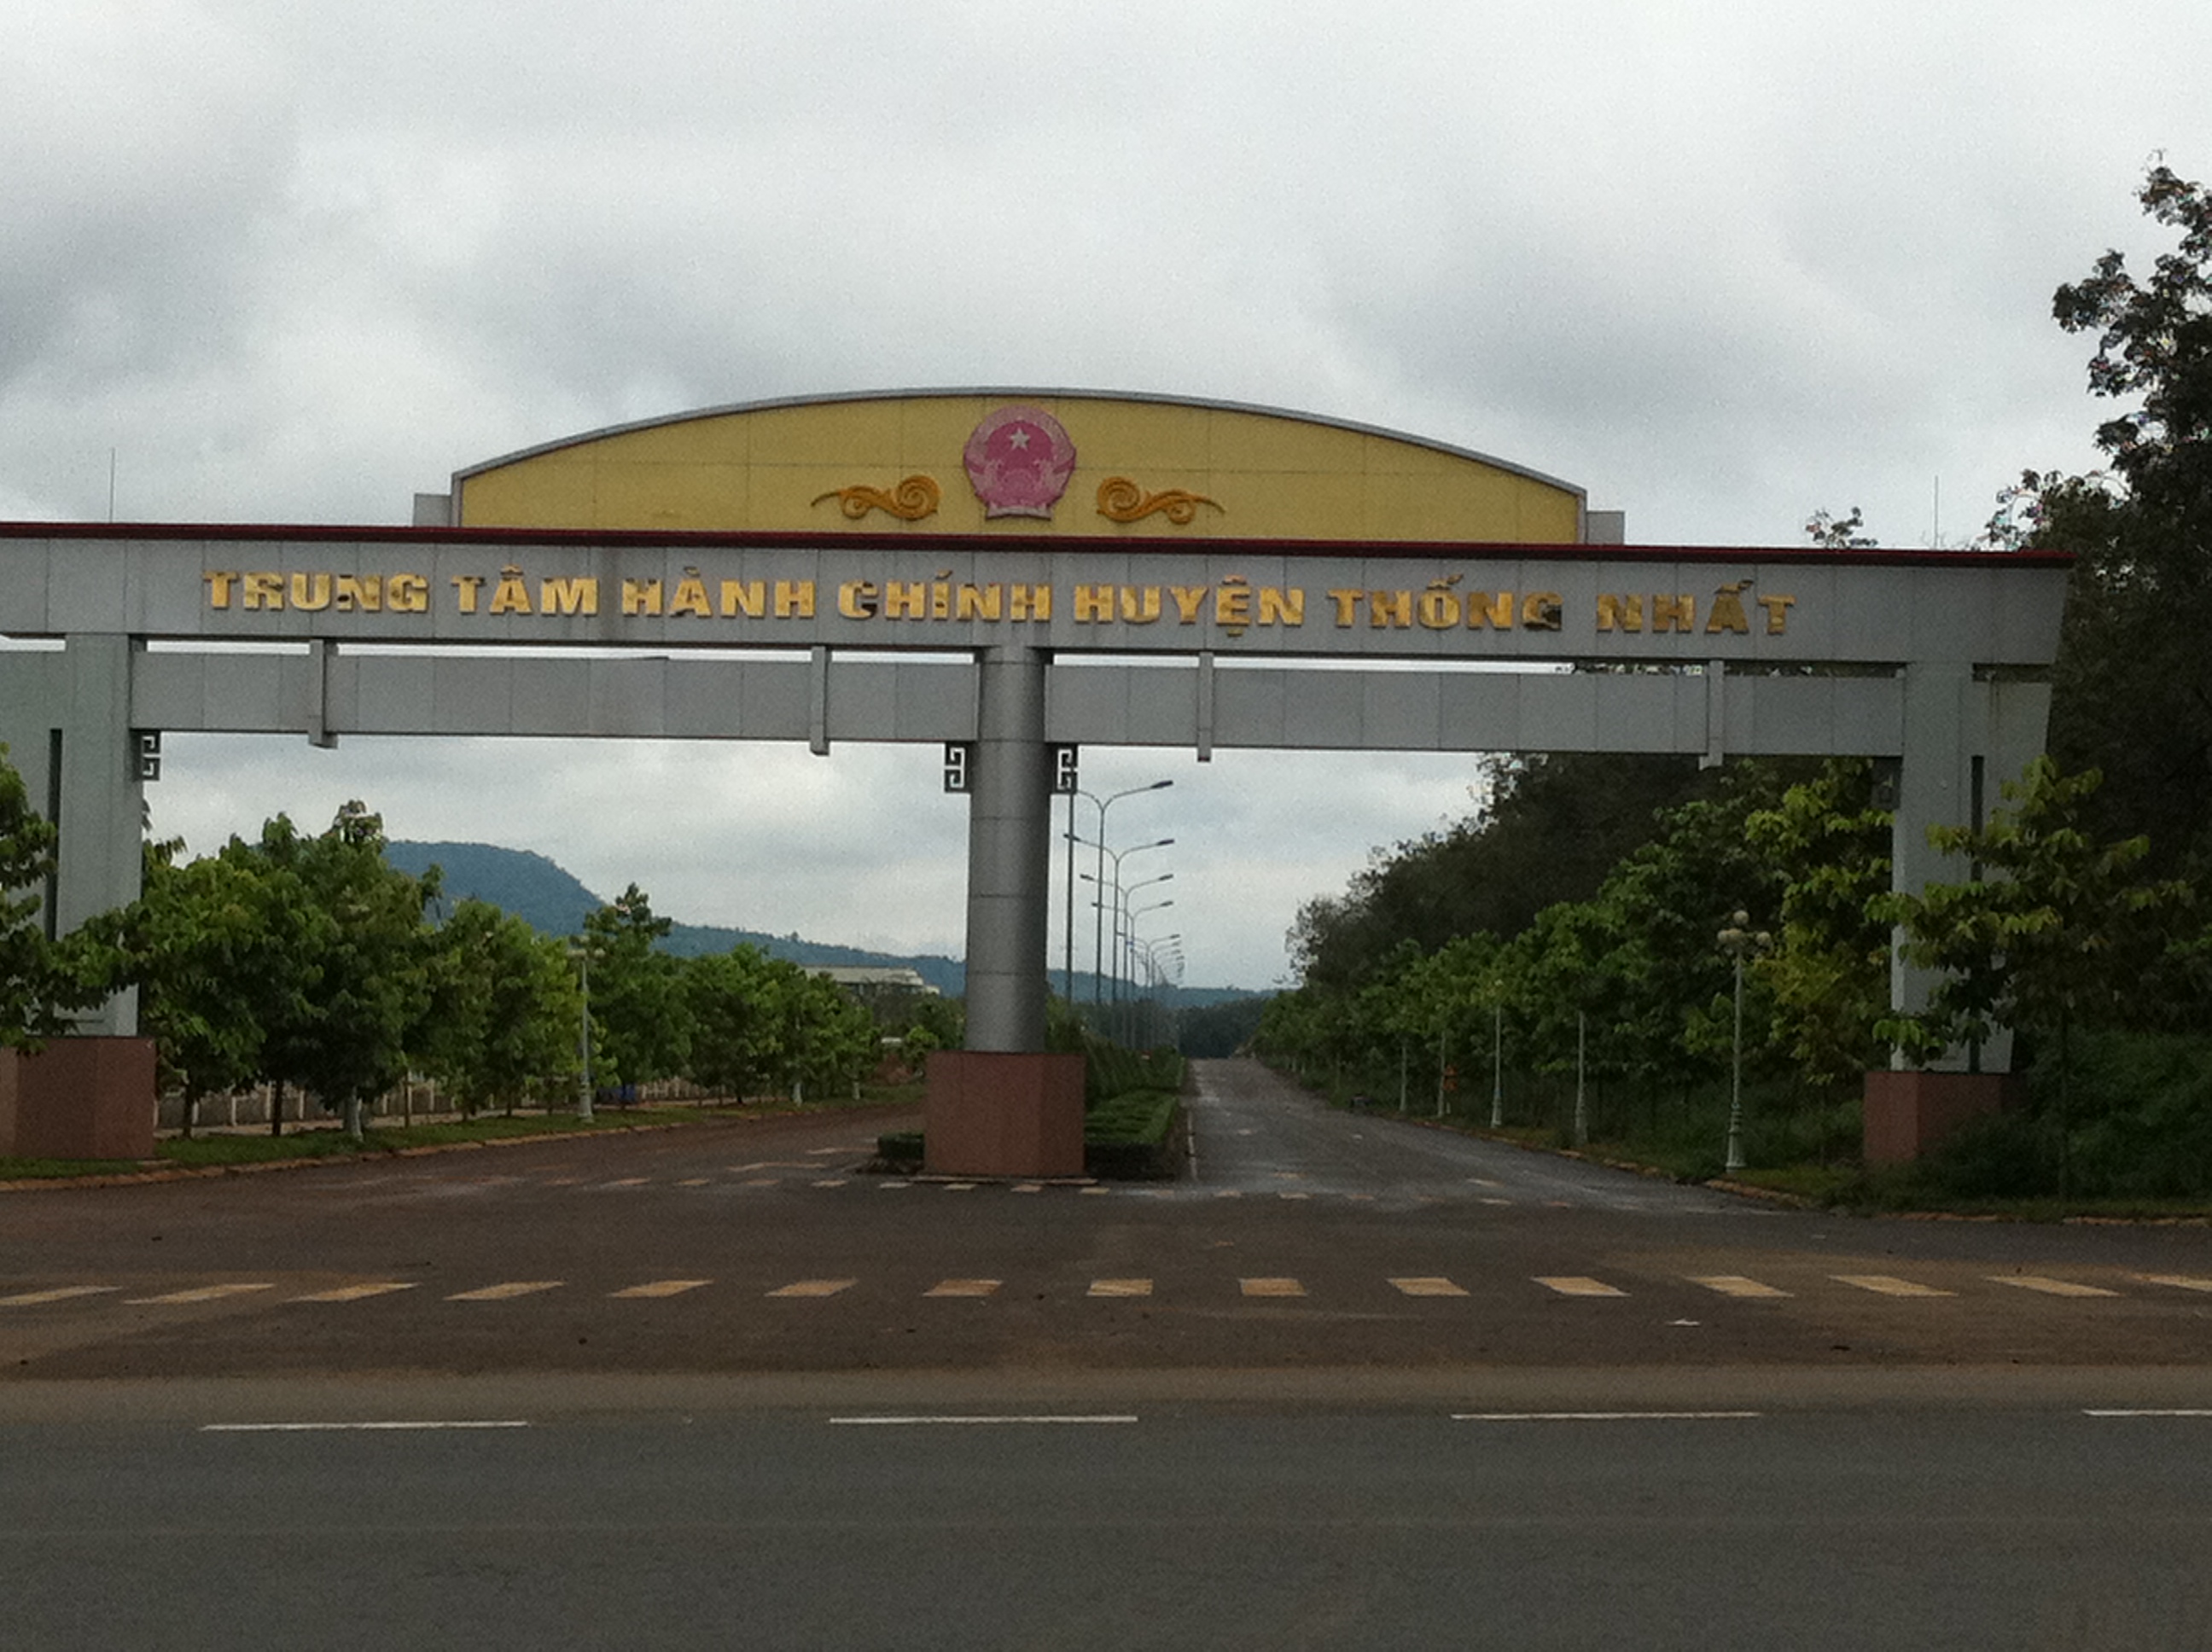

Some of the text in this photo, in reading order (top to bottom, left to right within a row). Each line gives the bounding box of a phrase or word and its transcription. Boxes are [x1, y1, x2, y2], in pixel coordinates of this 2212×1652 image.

[203, 564, 1797, 637] TRUNG TÂM HÀNH CHÍNH HUYỆN THỐNG NHẤT
